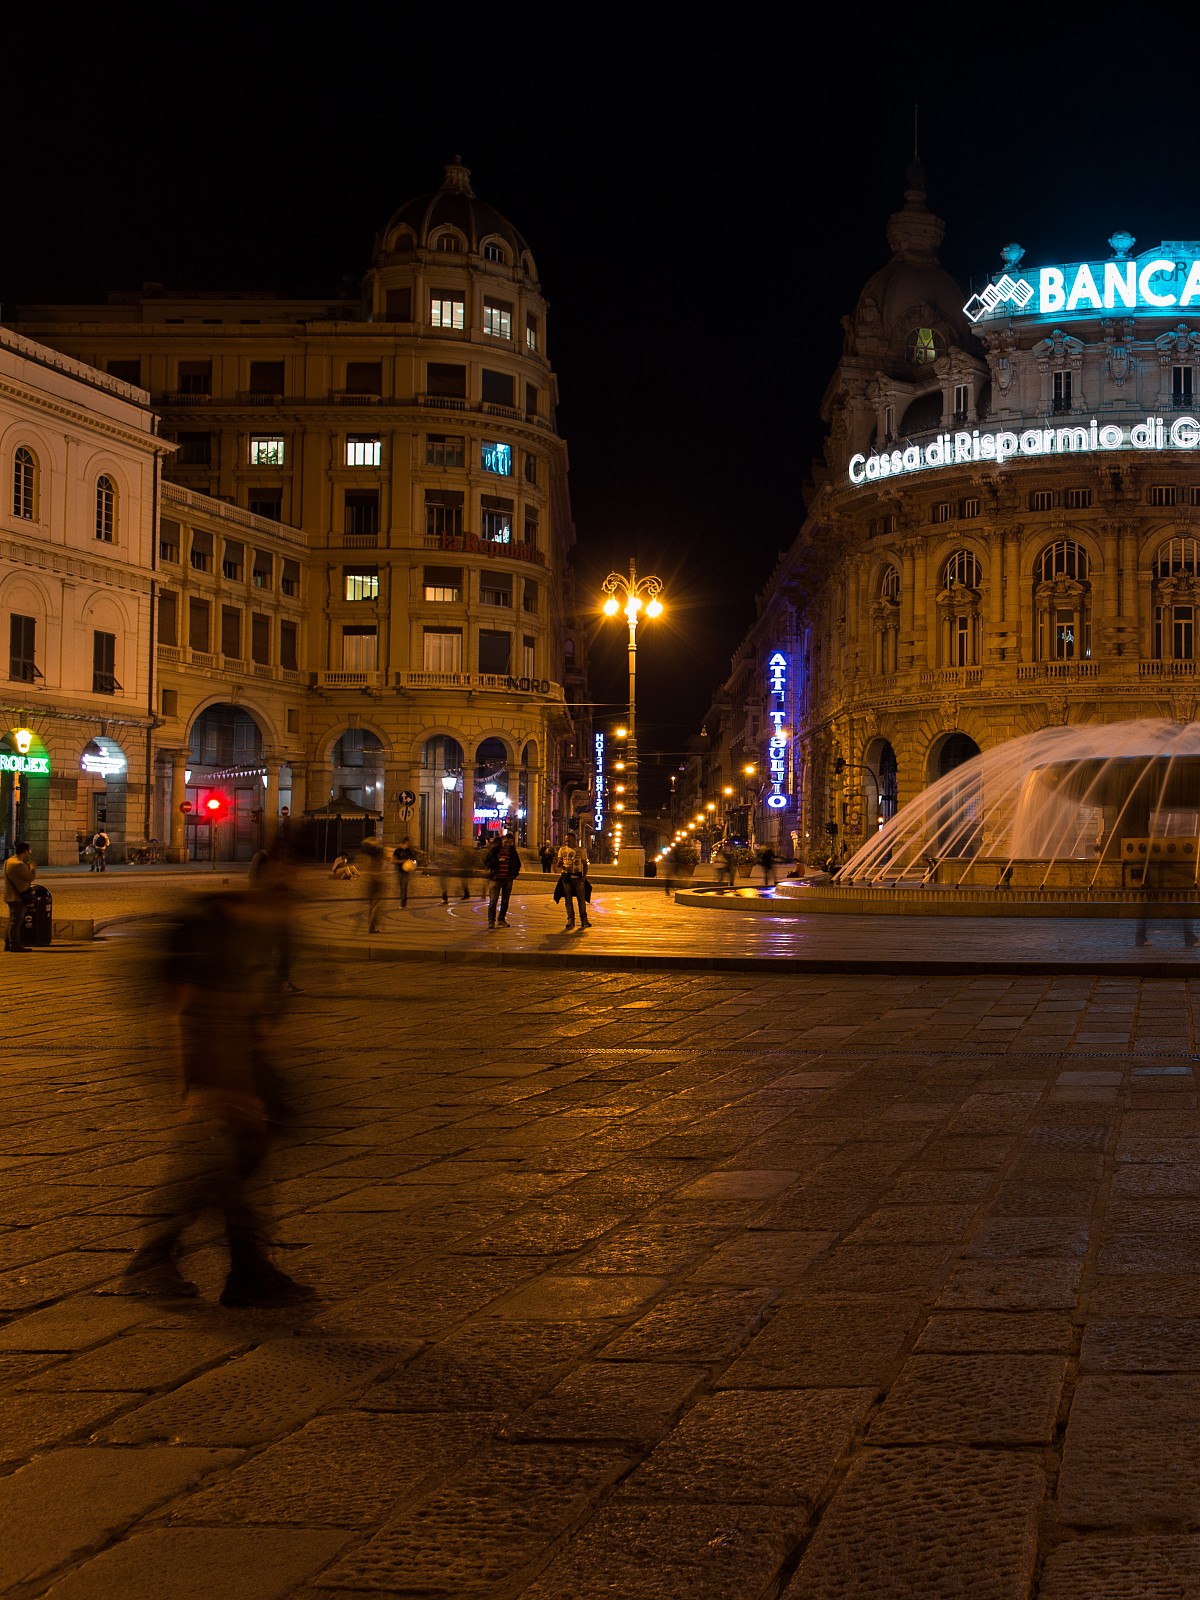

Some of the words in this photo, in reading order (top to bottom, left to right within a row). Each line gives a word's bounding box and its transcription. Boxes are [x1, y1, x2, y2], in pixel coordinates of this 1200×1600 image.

[848, 444, 920, 484] Cassa
[925, 433, 951, 467] di
[954, 419, 1124, 464] Risparmio
[1130, 416, 1164, 450] di
[507, 675, 551, 694] NORD
[0, 754, 50, 773] ROLEX
